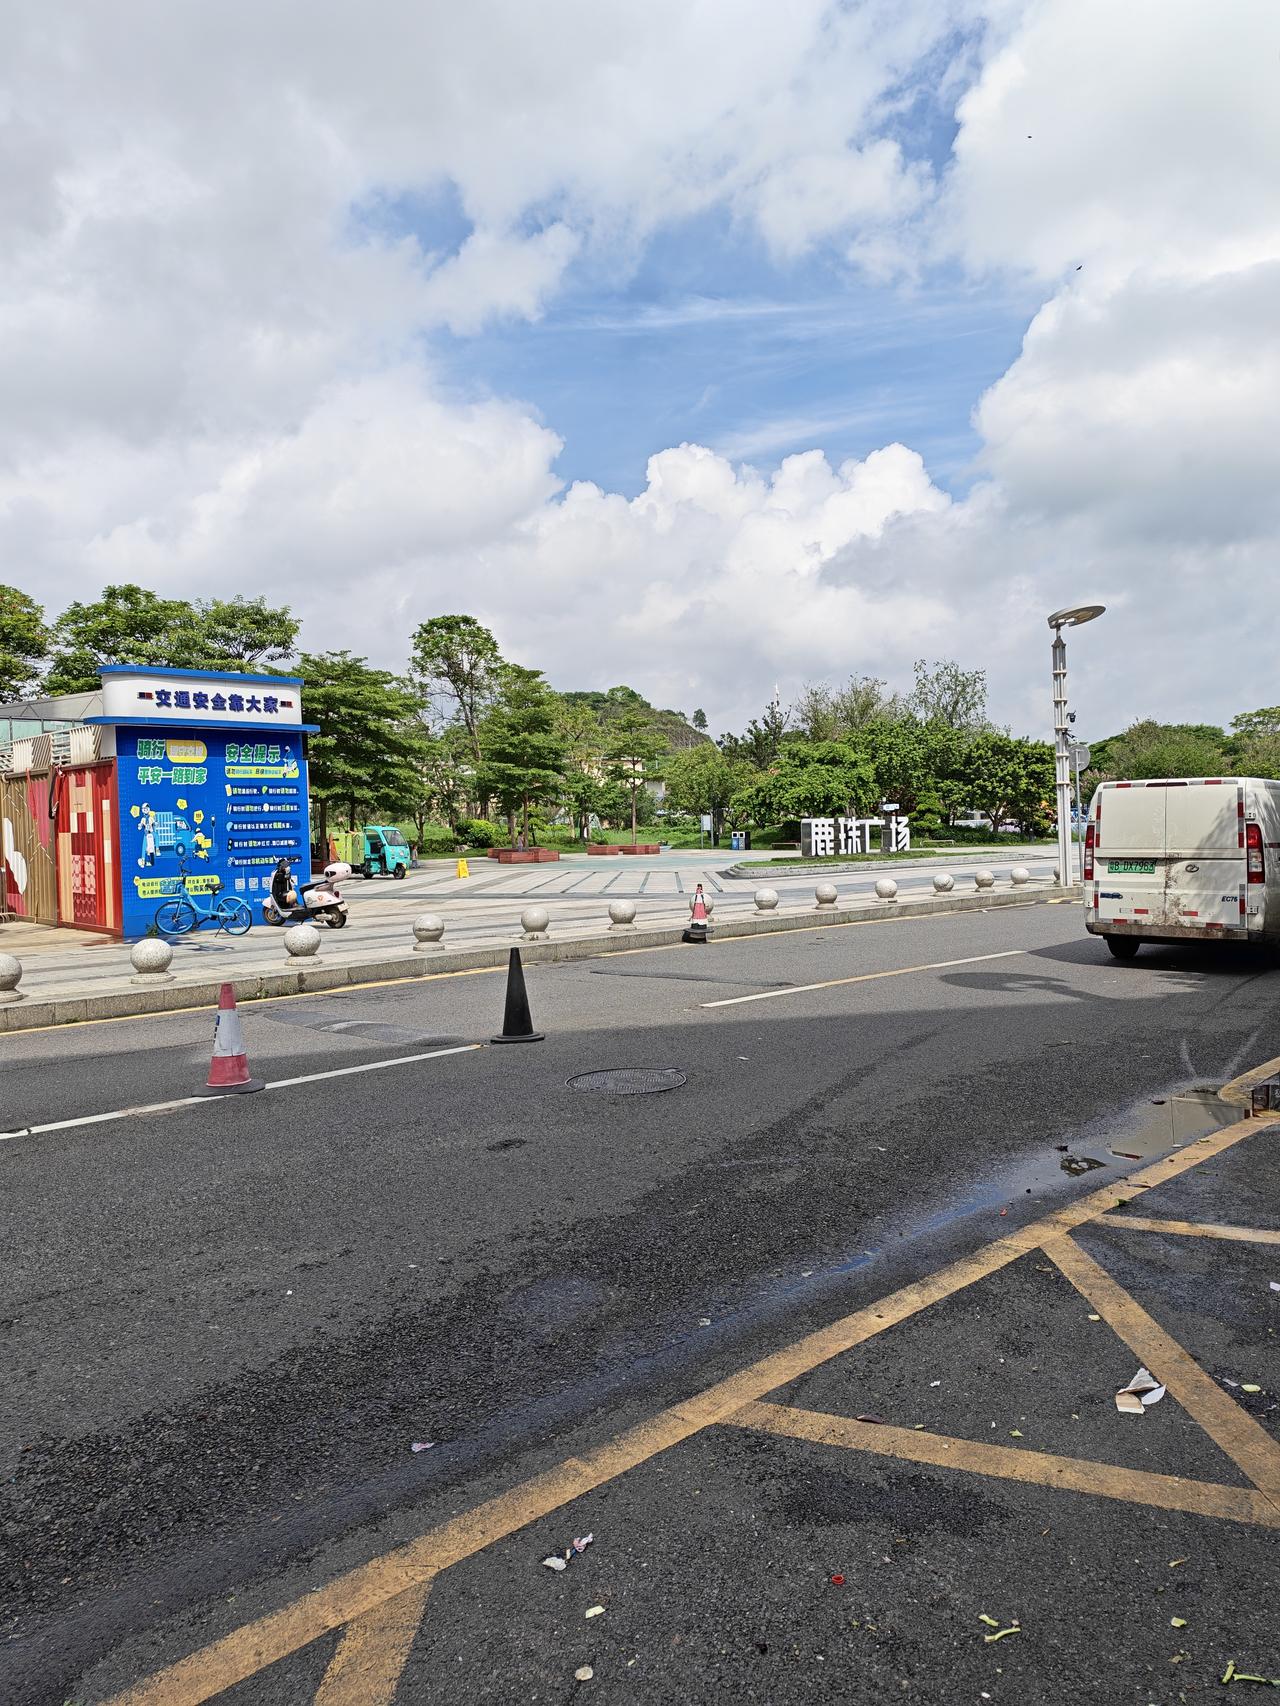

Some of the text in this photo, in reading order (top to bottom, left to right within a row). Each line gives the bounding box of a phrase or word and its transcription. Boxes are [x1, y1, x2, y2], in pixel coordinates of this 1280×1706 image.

[155, 689, 279, 714] 交通安全靠大家
[225, 743, 280, 764] 安全提示
[138, 766, 208, 785] 平安一路到家
